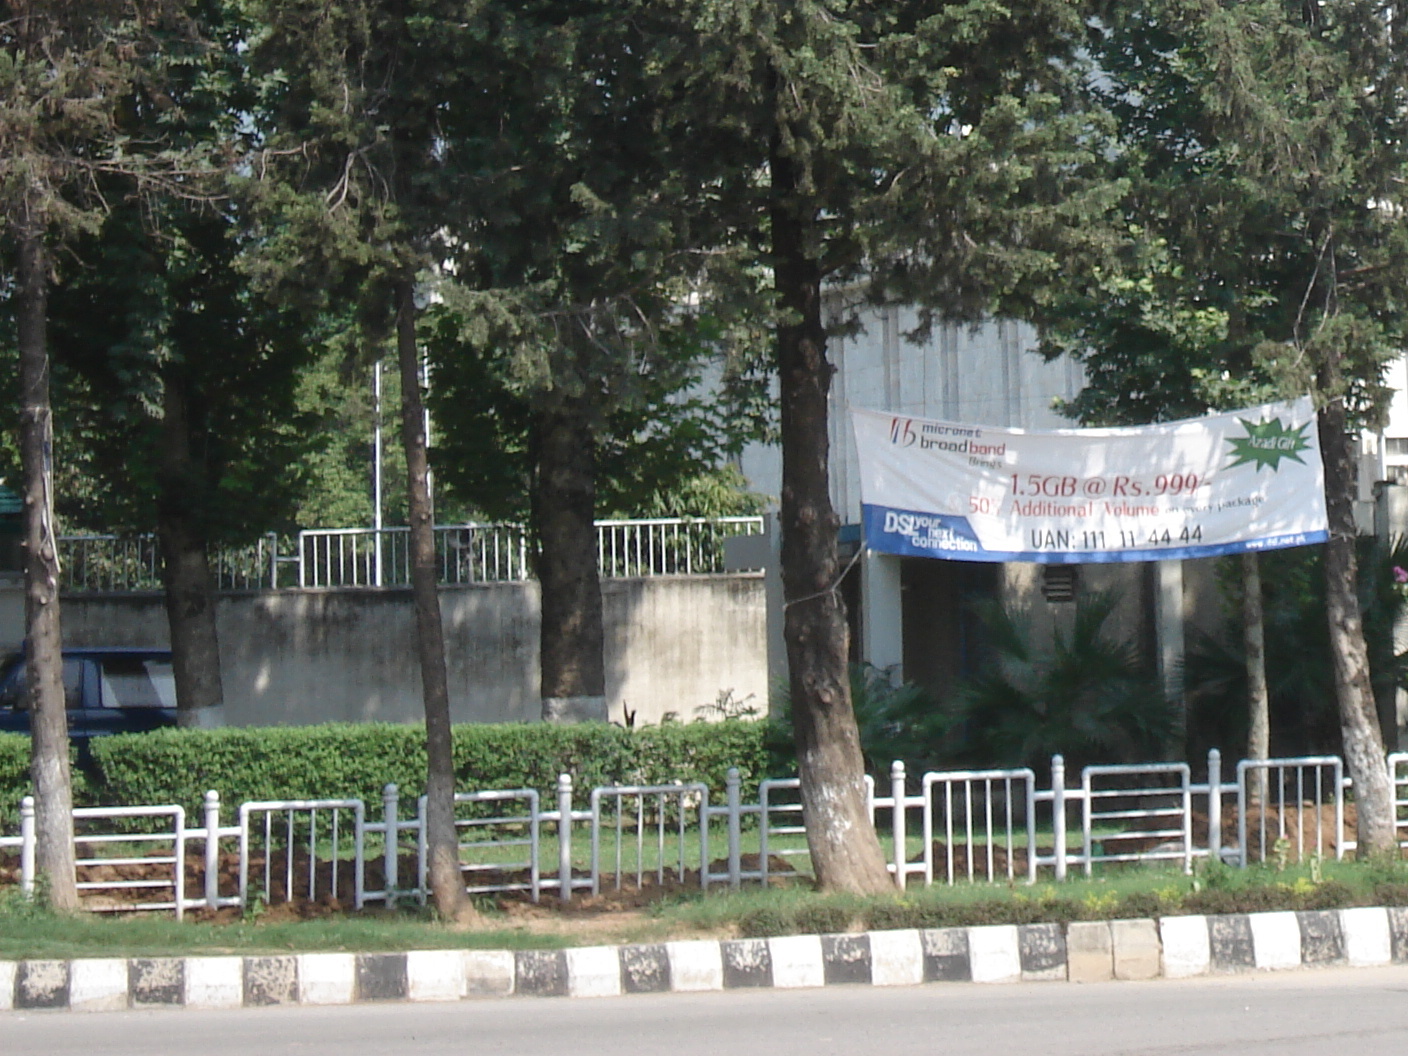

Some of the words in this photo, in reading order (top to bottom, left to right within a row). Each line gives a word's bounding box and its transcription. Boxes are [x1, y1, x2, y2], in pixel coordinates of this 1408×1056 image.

[922, 424, 982, 438] micronet
[920, 435, 1006, 456] broadband
[1010, 472, 1078, 498] 1.5GB
[1082, 476, 1107, 500] @
[1010, 498, 1094, 518] Additional
[1104, 500, 1160, 517] Volume
[1217, 495, 1265, 513] package
[883, 511, 920, 537] DSL
[914, 515, 942, 529] your
[927, 526, 954, 540] next
[1031, 528, 1077, 549] UAN:
[1083, 530, 1106, 550] 111
[1119, 530, 1136, 548] 11
[1148, 528, 1172, 547] 44
[1179, 524, 1203, 545] 44
[911, 535, 978, 553] connection
